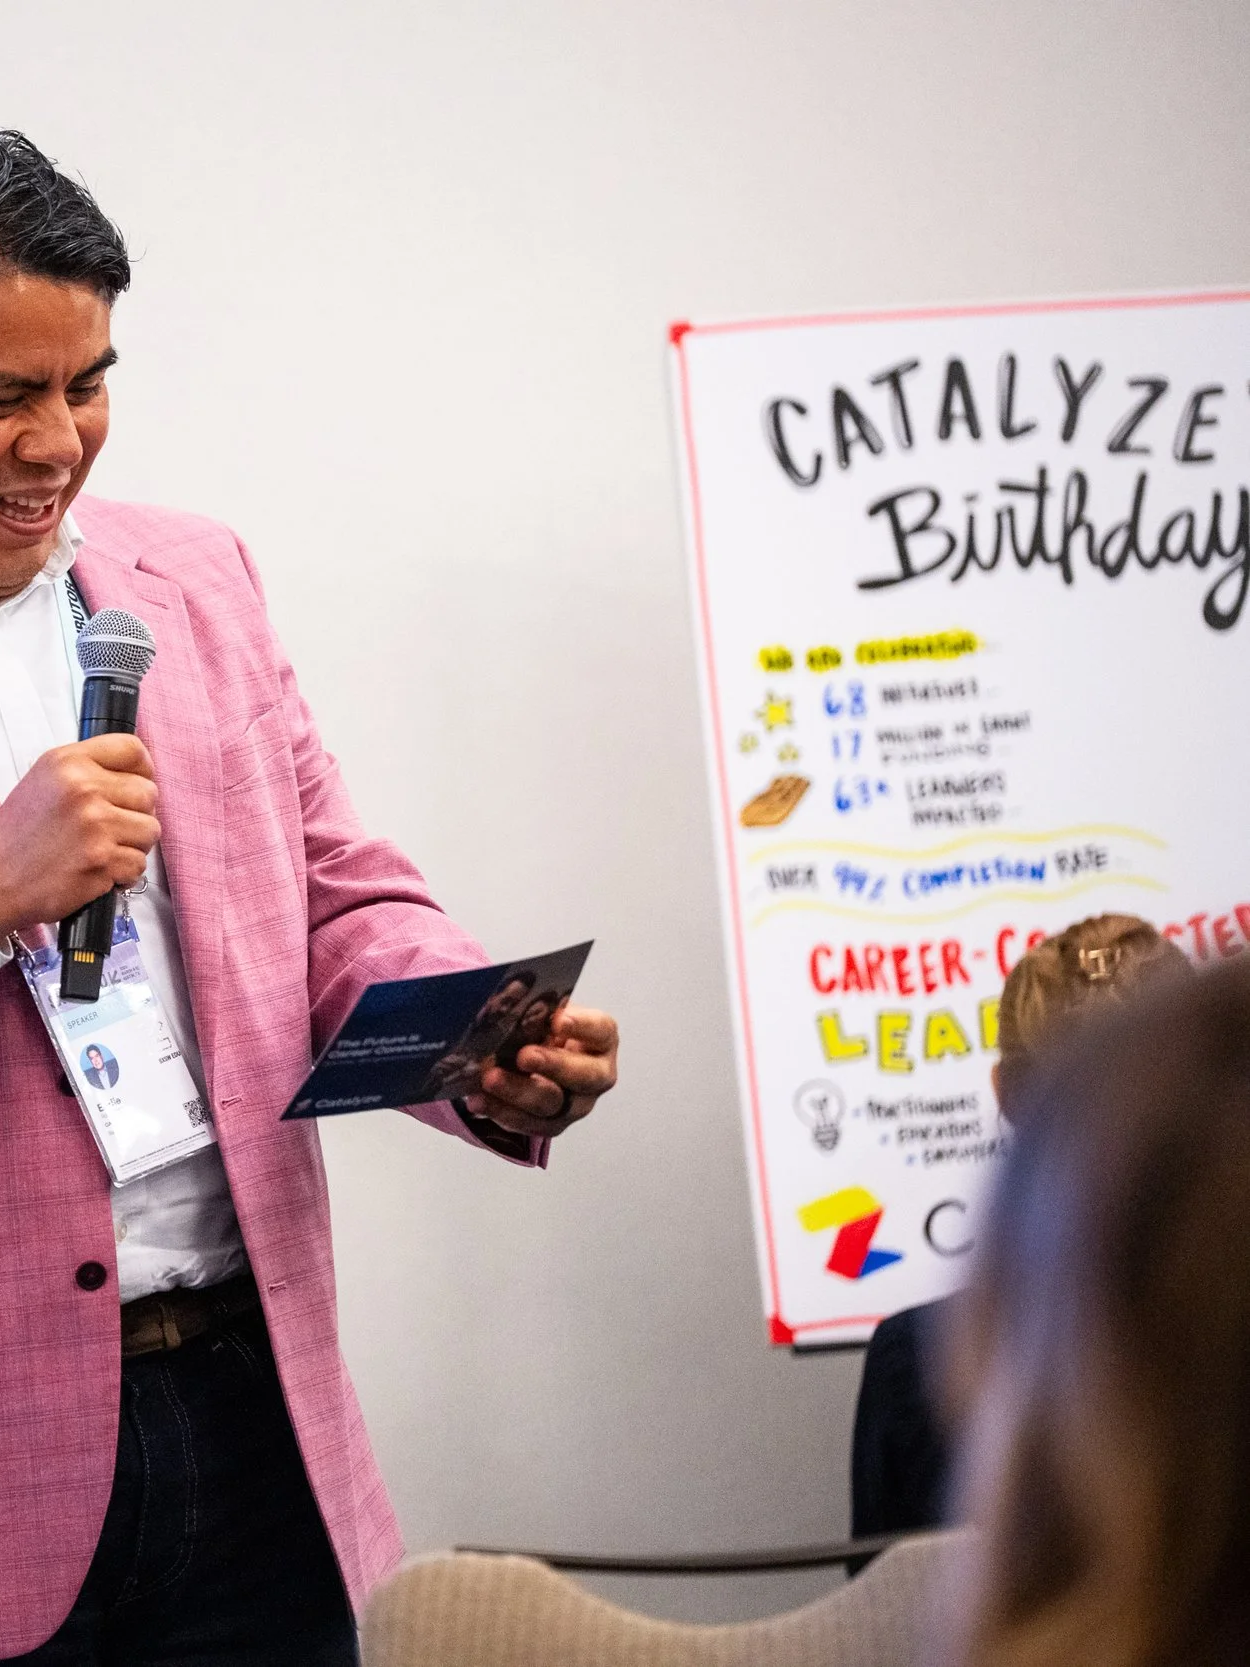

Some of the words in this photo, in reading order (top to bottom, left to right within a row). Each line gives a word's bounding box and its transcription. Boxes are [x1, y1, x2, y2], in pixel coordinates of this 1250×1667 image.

[856, 464, 1250, 631] Birthday
[64, 579, 85, 633] BUTOR
[66, 1011, 99, 1030] SPEAKER
